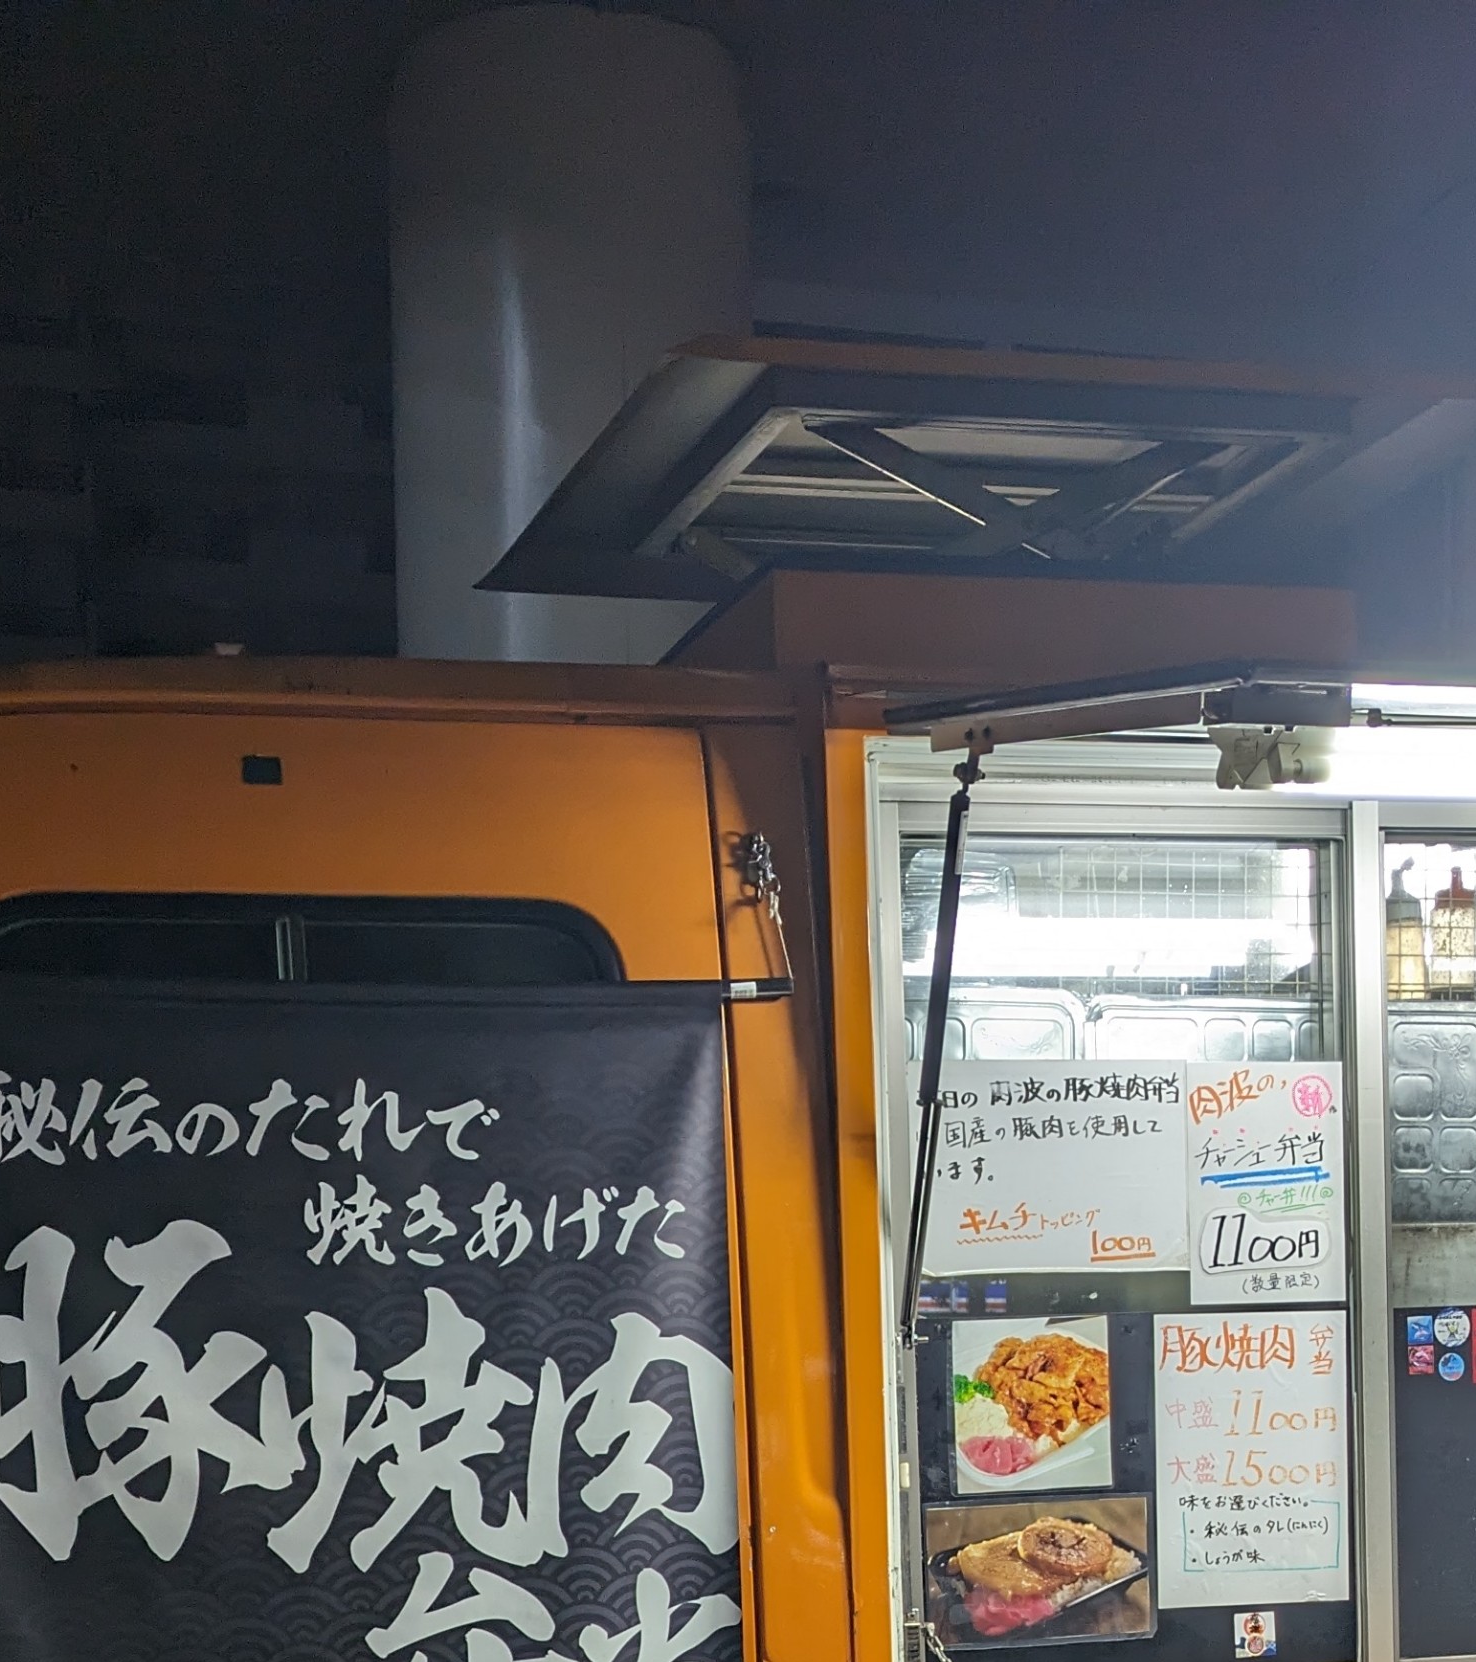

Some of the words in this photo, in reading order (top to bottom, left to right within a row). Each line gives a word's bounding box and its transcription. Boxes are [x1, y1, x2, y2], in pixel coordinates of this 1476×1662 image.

[304, 1174, 686, 1266] 焼きあげた
[1208, 1213, 1319, 1269] 1100円
[1091, 1229, 1152, 1254] 100円
[1223, 1389, 1337, 1436] 1100円
[1222, 1450, 1337, 1487] 1500円
[1205, 1549, 1265, 1566] しょうが味
